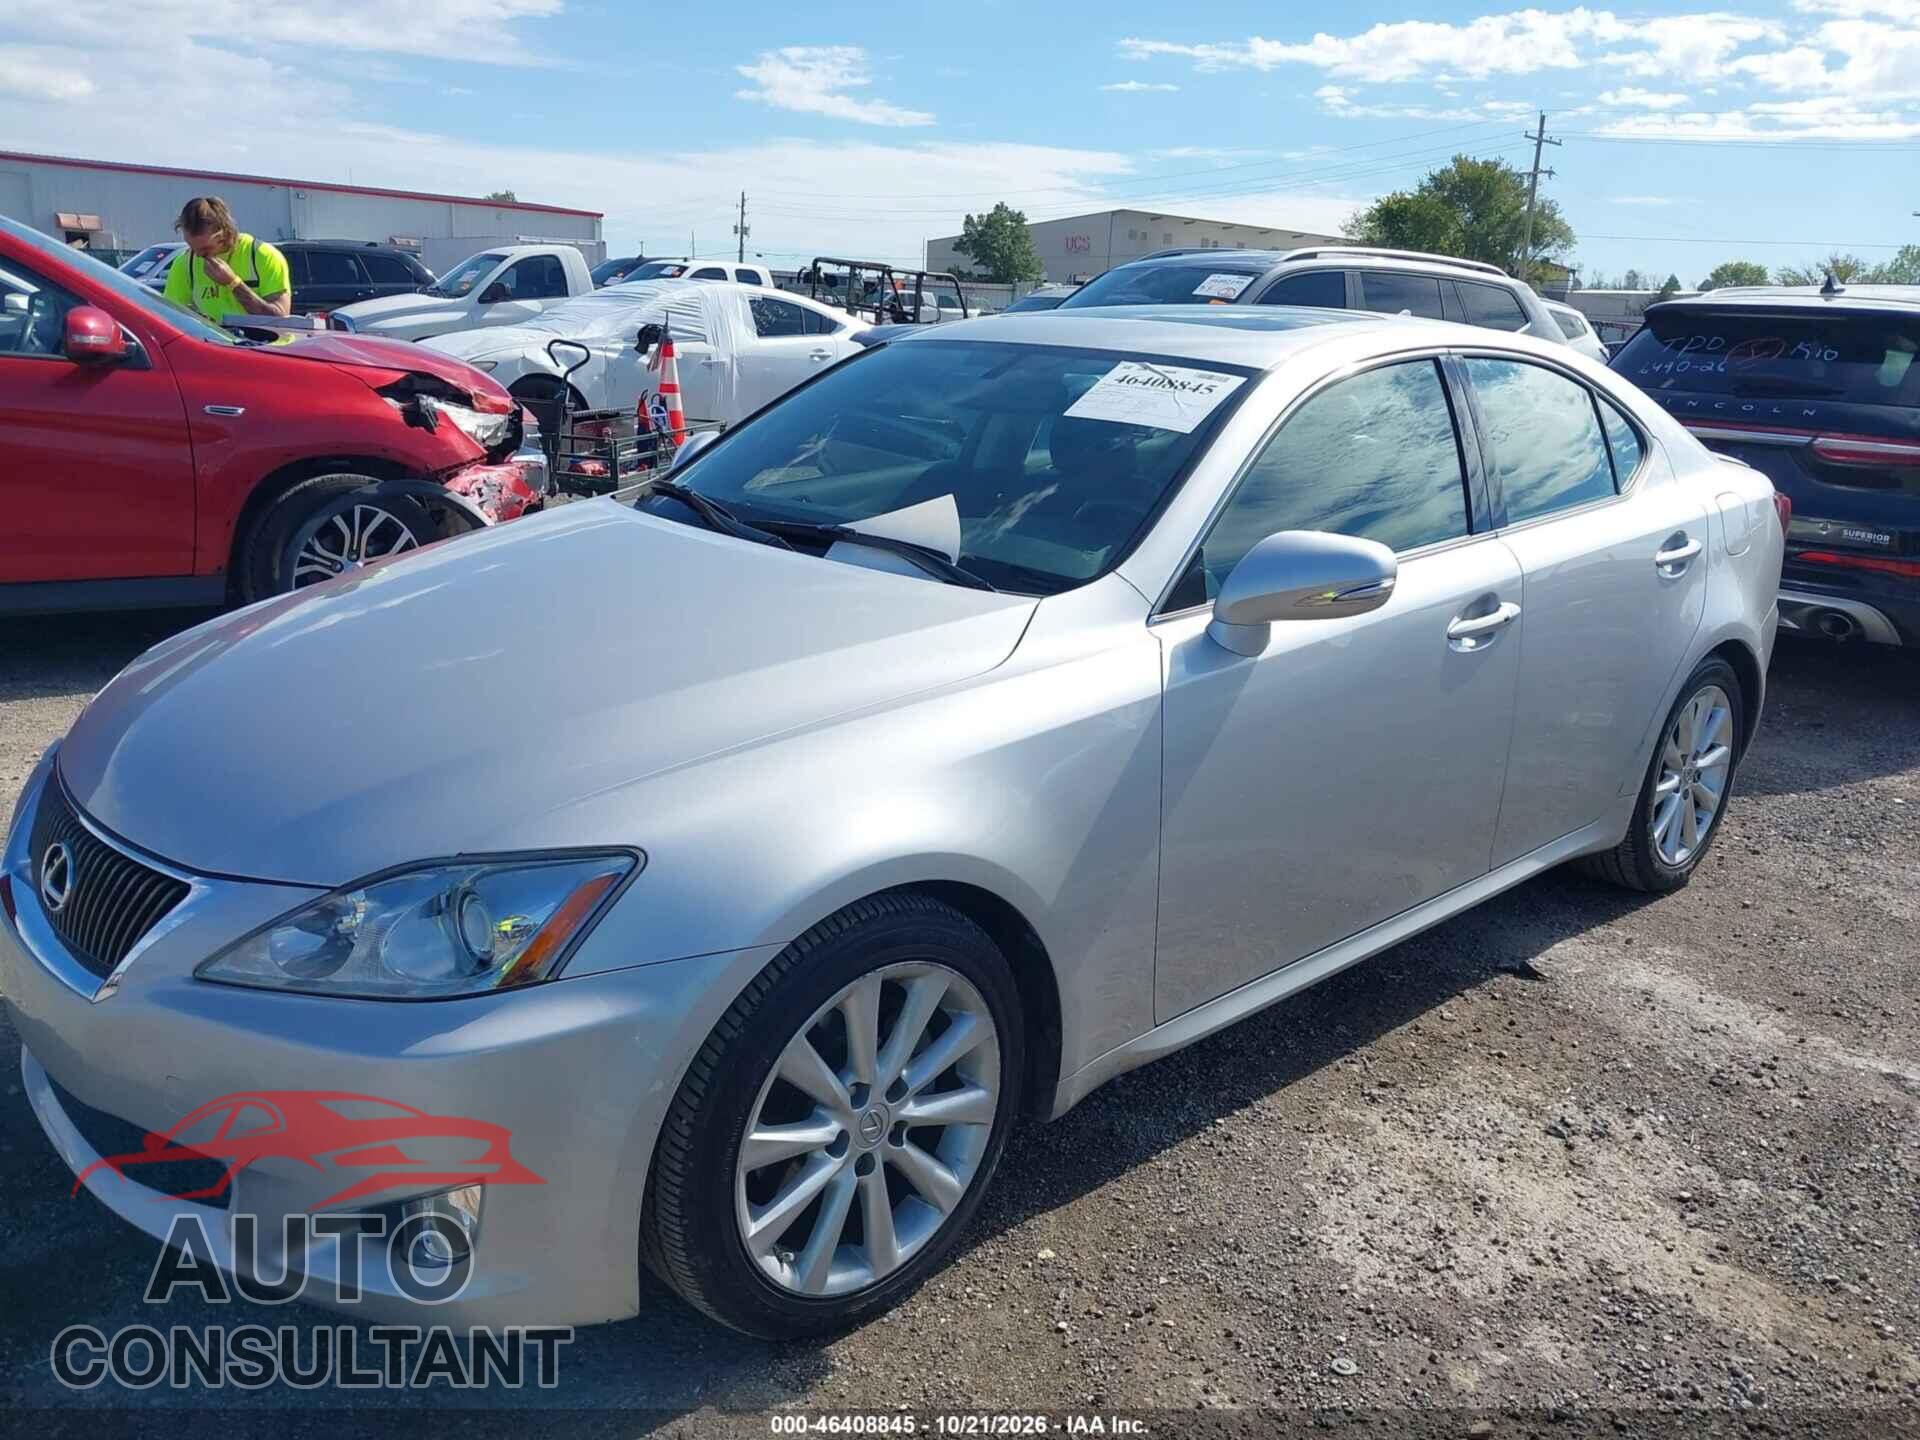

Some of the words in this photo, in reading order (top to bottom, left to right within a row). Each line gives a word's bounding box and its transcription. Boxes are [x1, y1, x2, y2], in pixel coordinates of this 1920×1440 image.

[1114, 373, 1219, 396] 46408845
[1666, 398, 1816, 416] INCOLN
[1843, 529, 1890, 541] SUPERIOR
